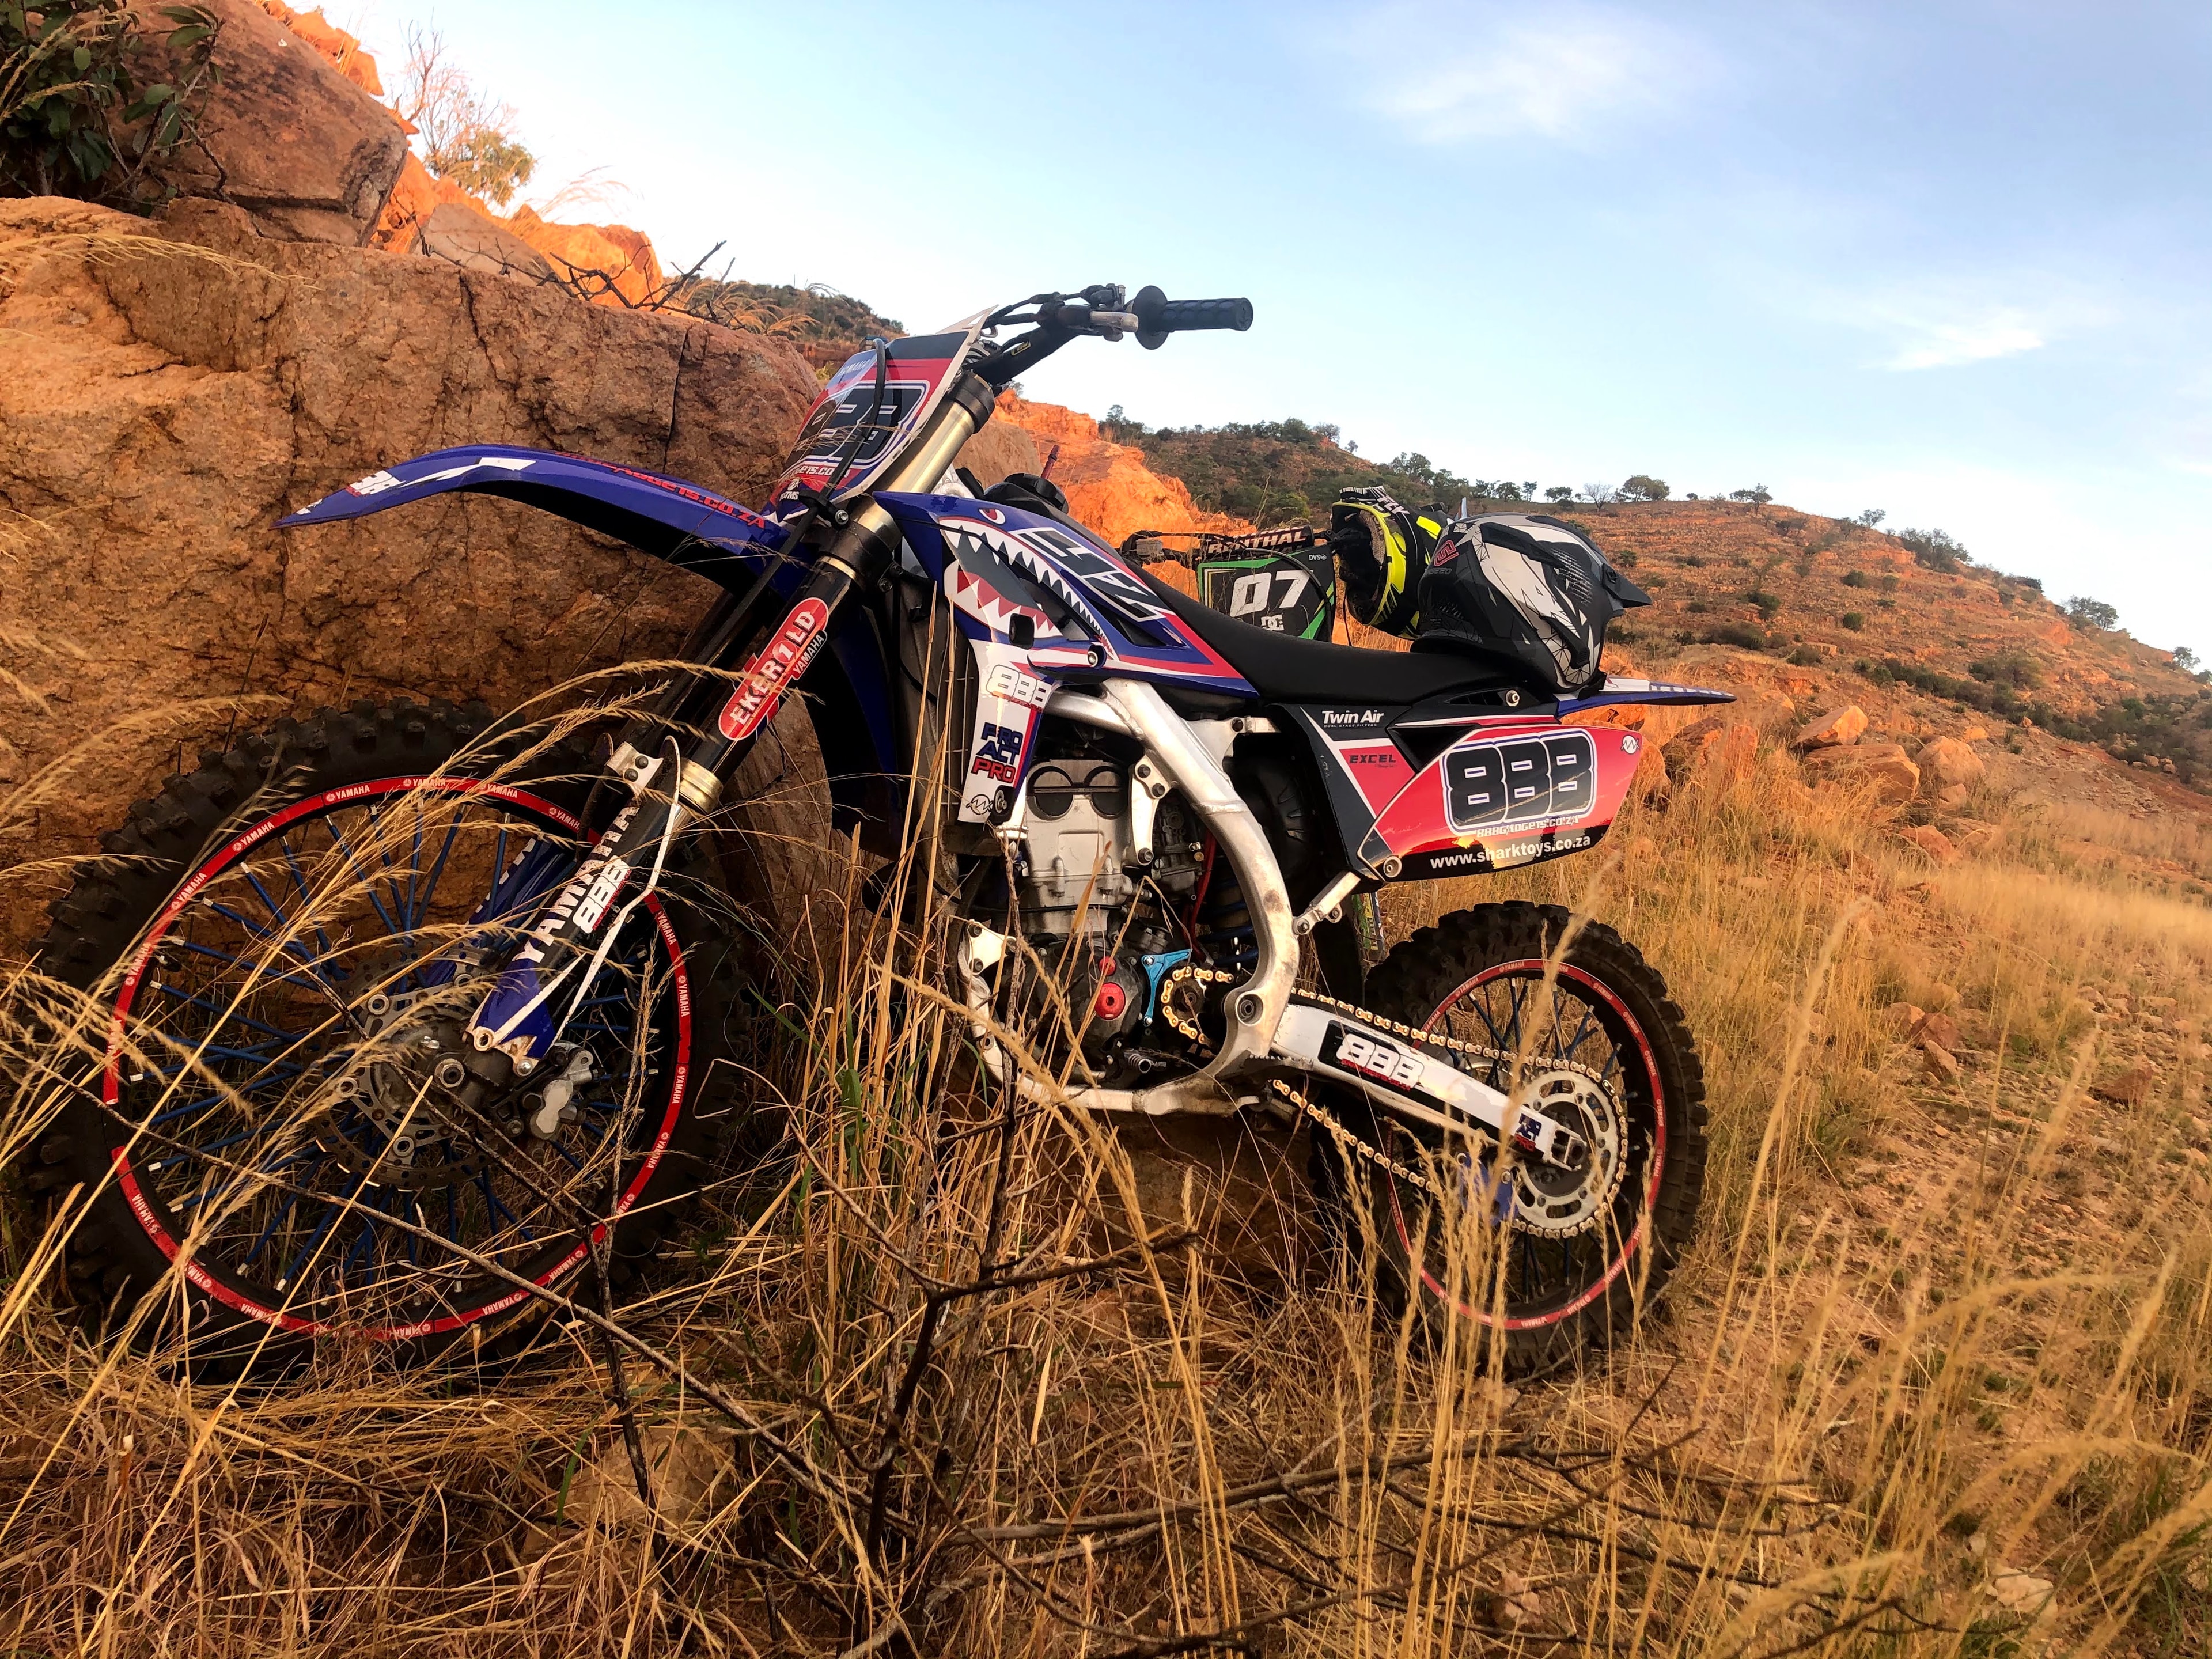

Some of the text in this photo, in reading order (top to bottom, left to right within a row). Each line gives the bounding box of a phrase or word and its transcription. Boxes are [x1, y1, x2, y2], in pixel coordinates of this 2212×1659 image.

[1229, 569, 1314, 618] 07
[793, 634, 824, 676] YAMAHA
[986, 664, 1050, 708] 888
[1322, 710, 1384, 724] Twin Air
[976, 740, 1020, 765] ACT
[1349, 754, 1396, 763] EXCEL
[971, 756, 1016, 784] PRO
[1442, 729, 1596, 835] 888
[335, 785, 370, 799] YAMAHA
[486, 781, 518, 800] YAMAHA
[241, 820, 274, 846] YAMAHA
[555, 808, 582, 832] YAMAH
[1430, 835, 1592, 869] www.sharktoys.co.za
[176, 870, 207, 903] YAMAHA
[572, 855, 631, 934] 888
[655, 914, 679, 945] YAMAHA
[1459, 976, 1479, 994] YAMAHA
[677, 984, 691, 1017] YAMAHA
[1422, 1010, 1441, 1031] YAMAHA
[1336, 1033, 1425, 1089] 888
[671, 1074, 685, 1104] YAMAHA
[131, 1193, 156, 1226] YAMAHA
[548, 1255, 577, 1281] YAMAHA
[482, 1295, 514, 1316] YAMAHA
